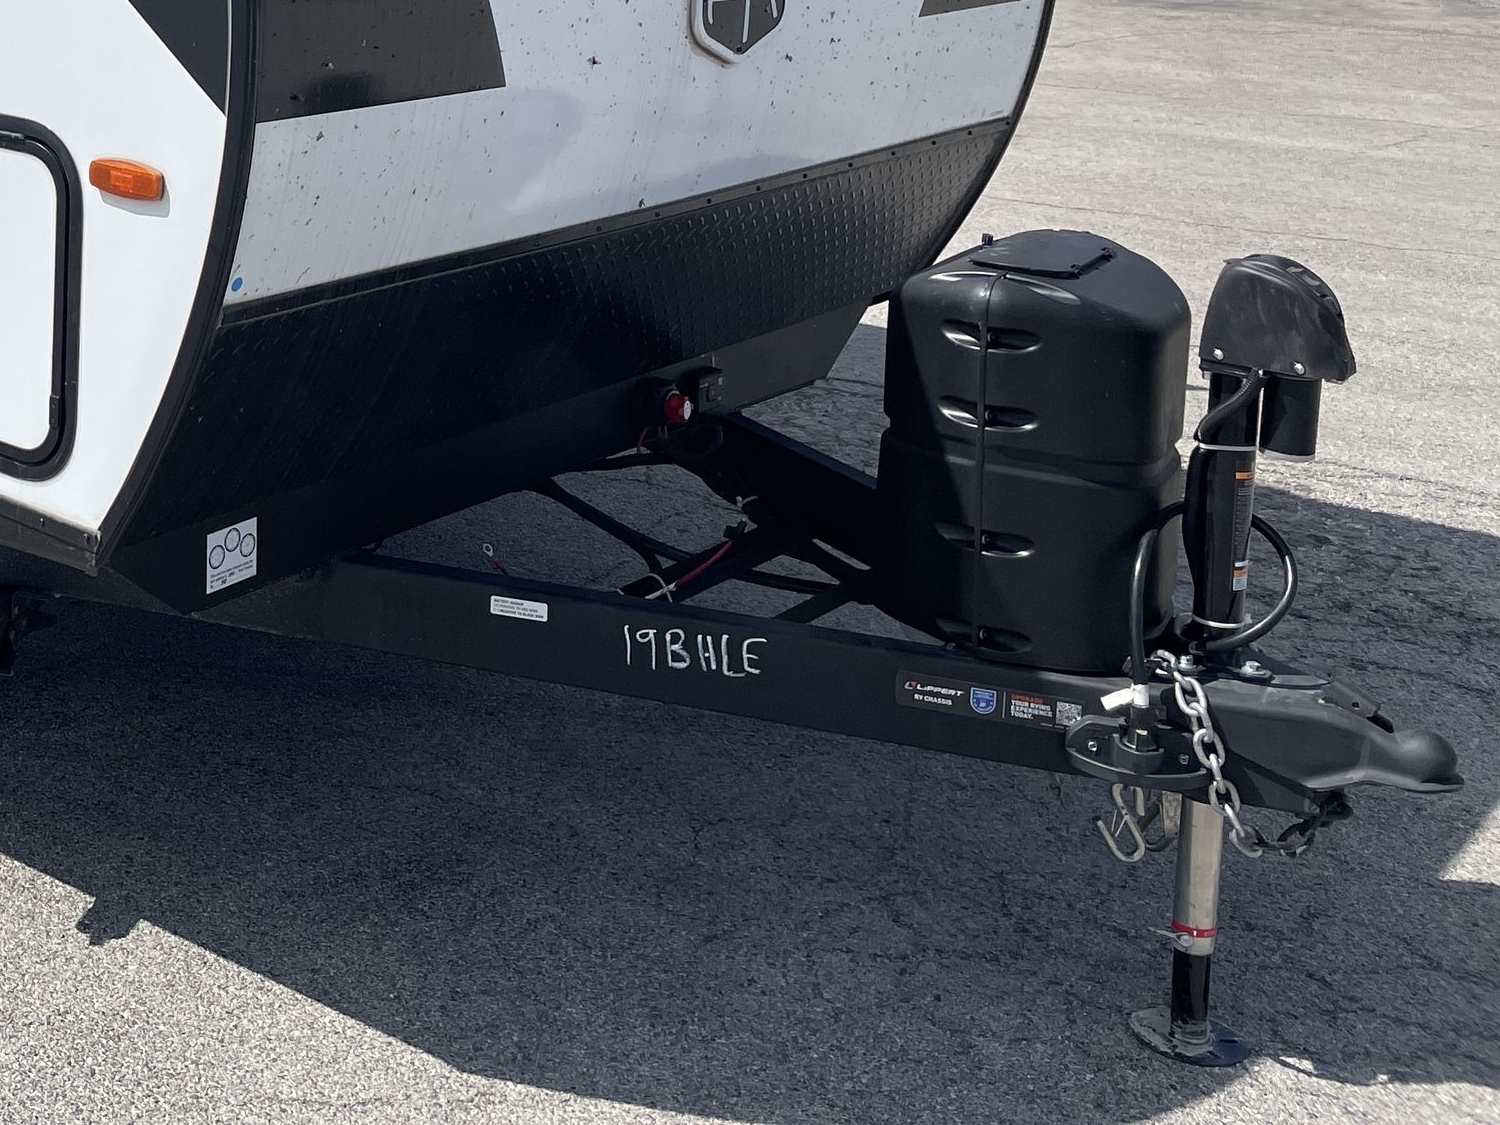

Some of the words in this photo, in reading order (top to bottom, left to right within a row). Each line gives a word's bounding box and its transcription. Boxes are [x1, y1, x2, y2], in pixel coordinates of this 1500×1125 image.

[623, 624, 768, 677] 19BHLE
[916, 683, 965, 697] LIPPERT
[924, 695, 953, 706] CHASSIS
